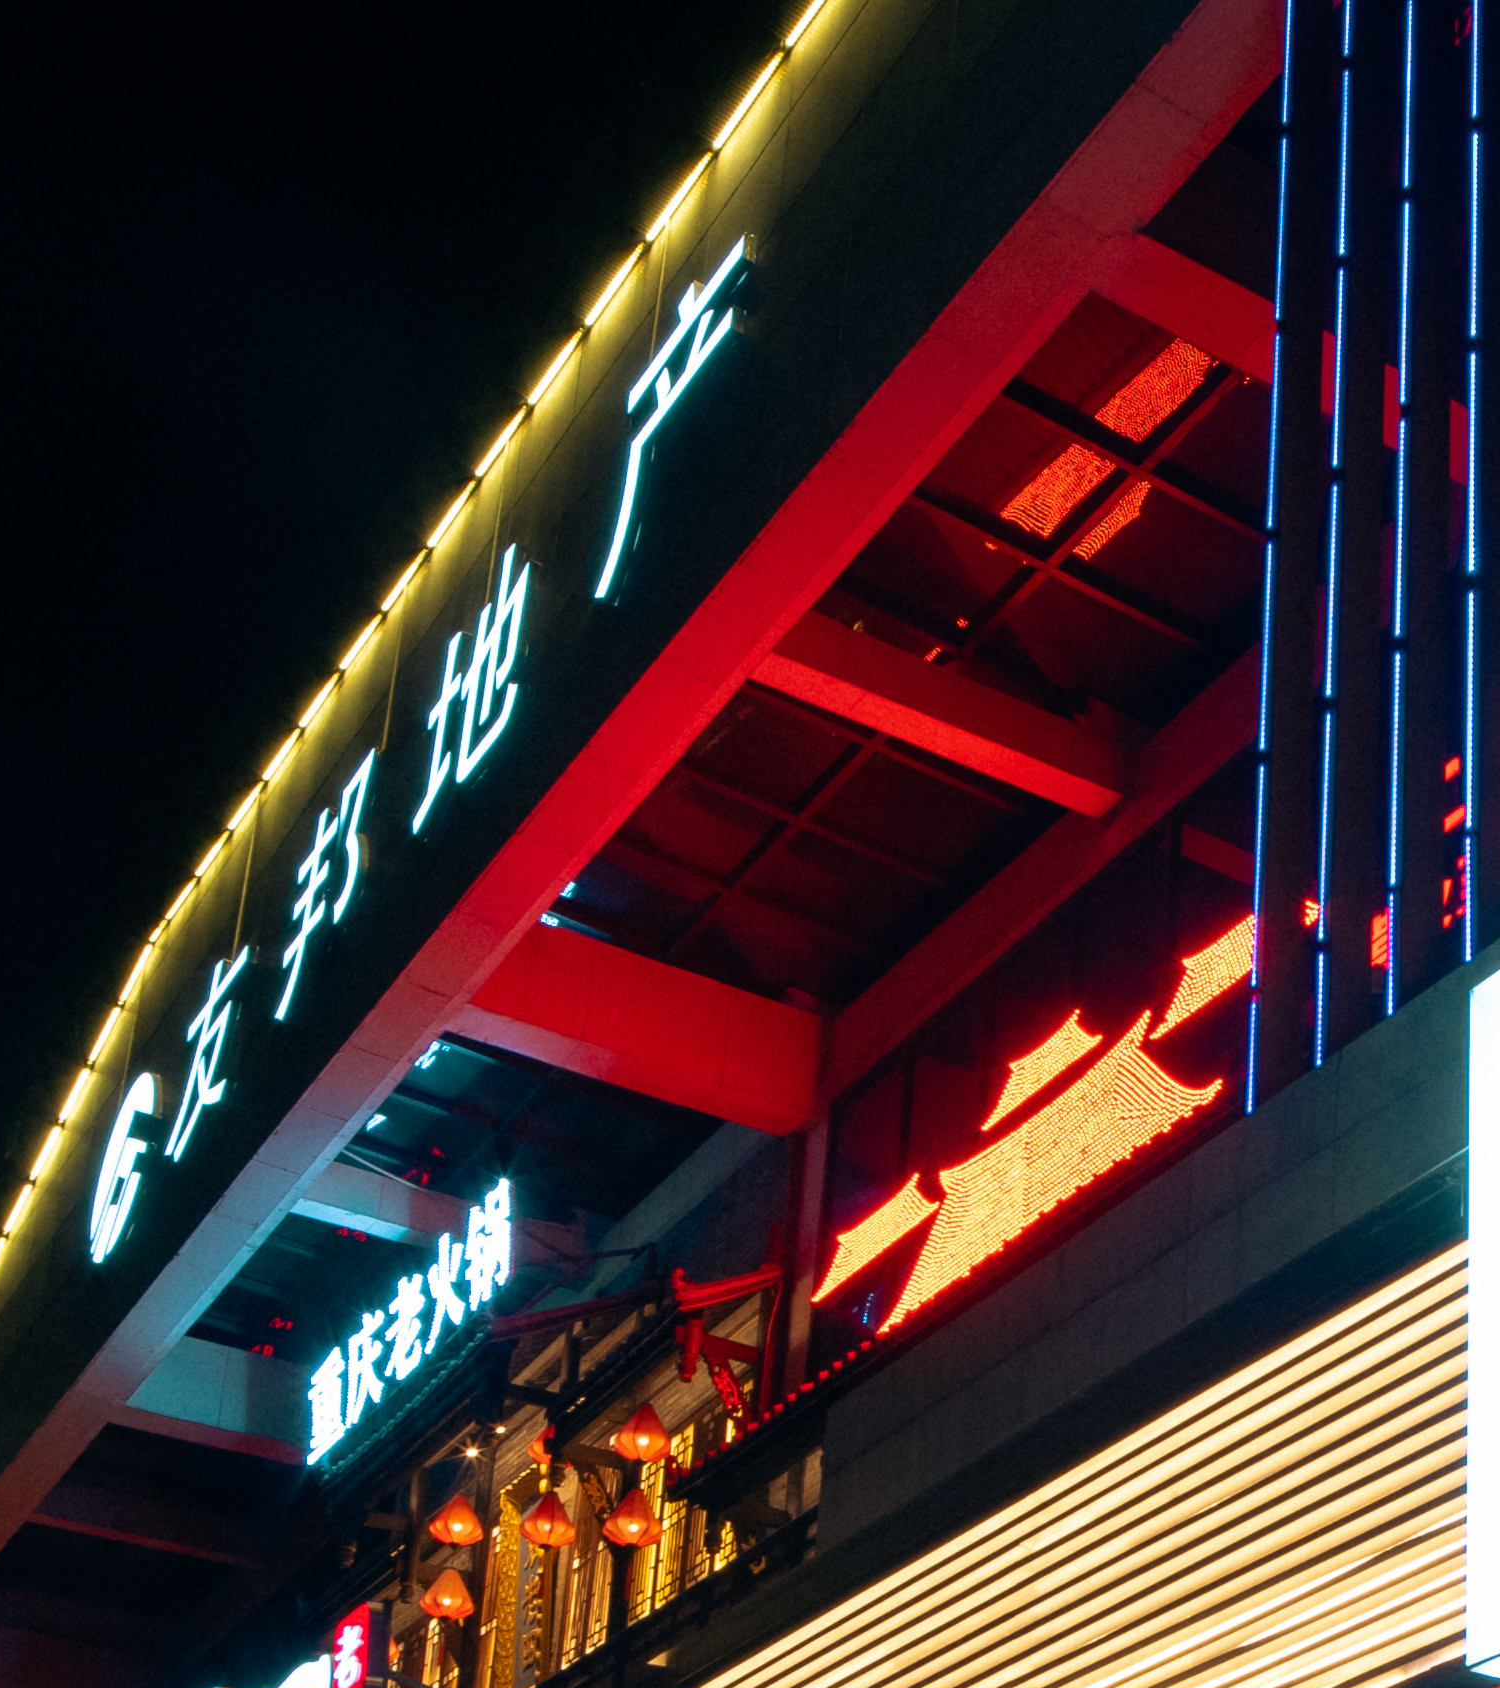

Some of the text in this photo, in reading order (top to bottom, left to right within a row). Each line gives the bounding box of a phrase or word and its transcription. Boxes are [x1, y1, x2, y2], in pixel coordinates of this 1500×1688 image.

[164, 233, 752, 1162] 友邦地产
[306, 1177, 514, 1467] 重庆老火锅
